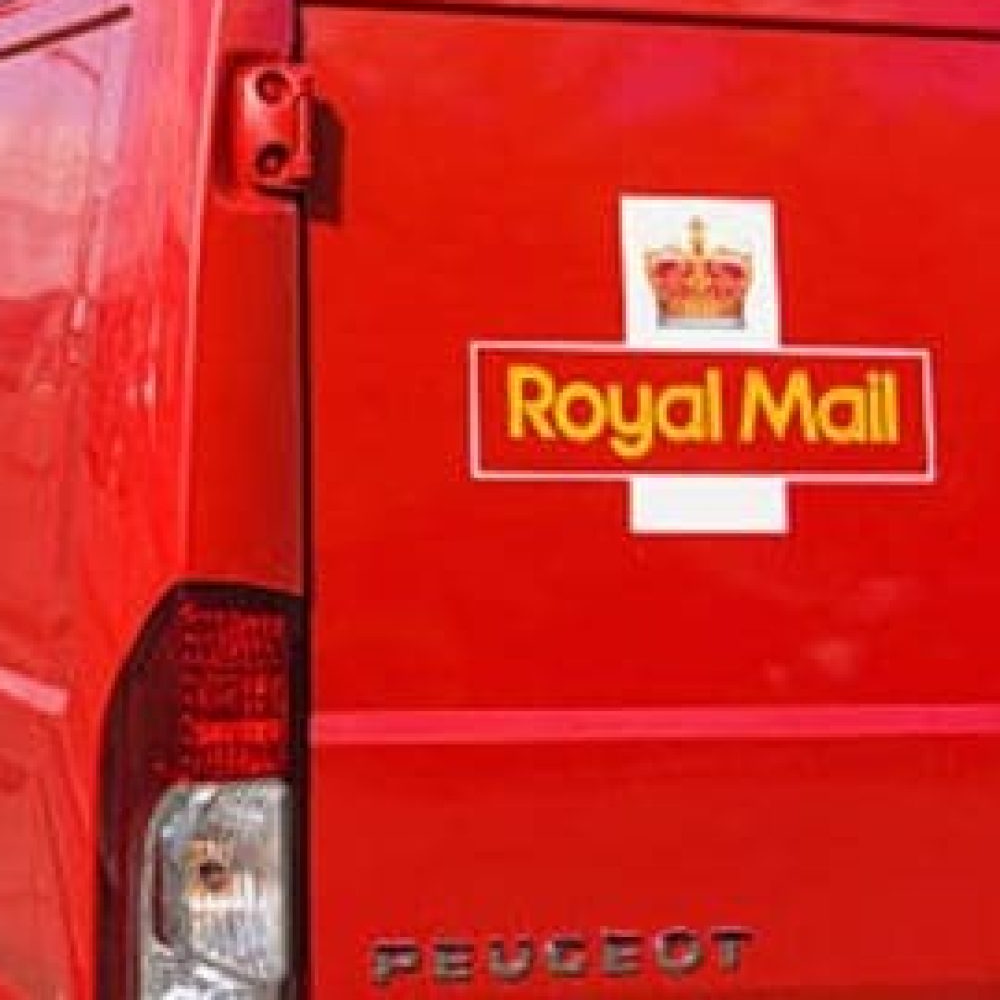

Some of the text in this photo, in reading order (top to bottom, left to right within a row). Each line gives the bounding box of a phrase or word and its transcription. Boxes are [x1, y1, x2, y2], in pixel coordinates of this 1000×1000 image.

[507, 365, 898, 460] Royal Mail
[370, 927, 754, 986] PEUGEOT
